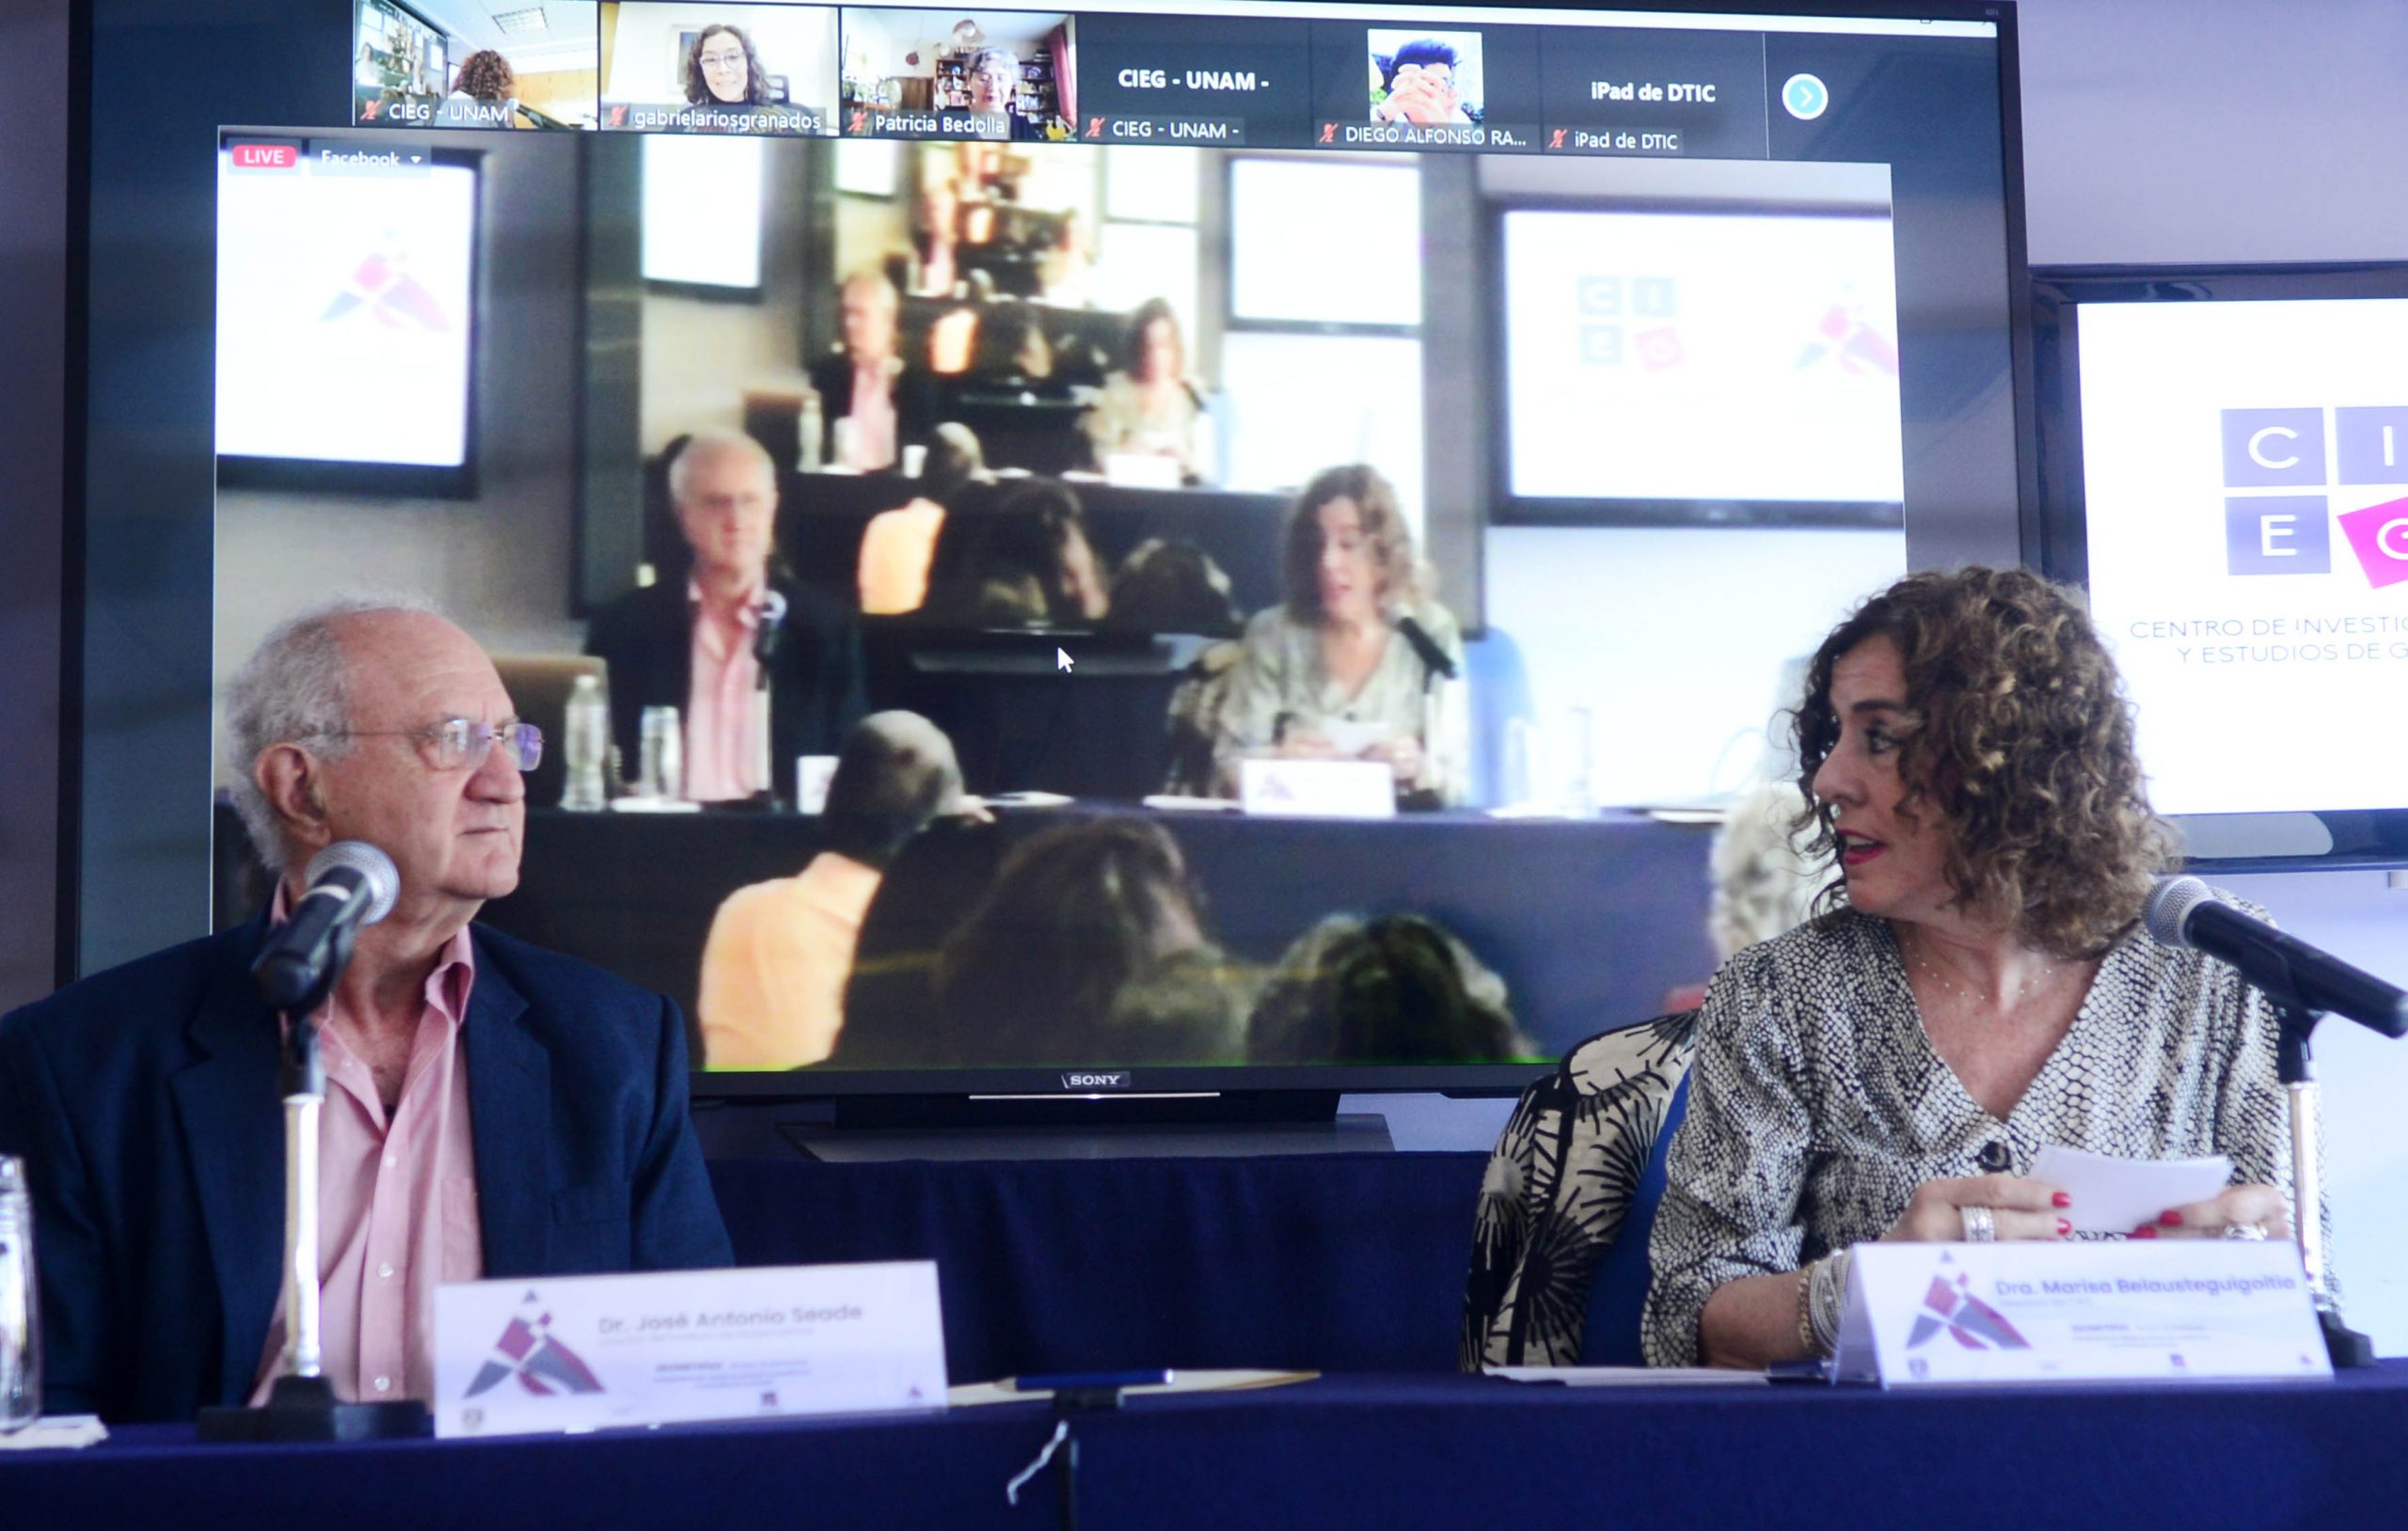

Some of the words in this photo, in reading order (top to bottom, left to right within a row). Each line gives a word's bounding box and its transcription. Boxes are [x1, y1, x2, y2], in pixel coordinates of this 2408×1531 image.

[1117, 69, 1167, 88] CIEG
[1186, 71, 1257, 91] UNAM
[1591, 81, 1635, 101] iPad
[1638, 83, 1664, 102] de
[1667, 83, 1717, 103] DTIC
[388, 103, 430, 120] CIEG
[450, 105, 509, 122] UNAM
[634, 109, 821, 131] gabrielariosgranados
[875, 114, 938, 133] Patricia
[942, 116, 1006, 134] Bedolla
[1112, 119, 1152, 137] CIEG
[1170, 121, 1228, 139] UNAM
[1345, 126, 1400, 144] DIEGO
[1403, 128, 1485, 145] ALFONSO
[1491, 130, 1528, 147] RA...
[1575, 131, 1611, 149] iPad
[1615, 132, 1637, 149] de
[1641, 134, 1679, 150] DTIC
[244, 150, 284, 165] LIVE
[321, 149, 401, 167] Facebook
[2130, 619, 2243, 639] CENTRO
[2253, 619, 2286, 636] DE
[2177, 647, 2192, 664] Y
[2202, 643, 2338, 663] ESTUDIOS
[2347, 642, 2381, 660] DE
[1069, 1075, 1121, 1086] SONY
[1996, 1280, 2037, 1296] Dra.
[2042, 1278, 2113, 1295] Marisa
[597, 1318, 629, 1335] Dr.
[637, 1313, 689, 1333] José
[695, 1308, 787, 1329] Antonio
[791, 1302, 863, 1323] Seade
